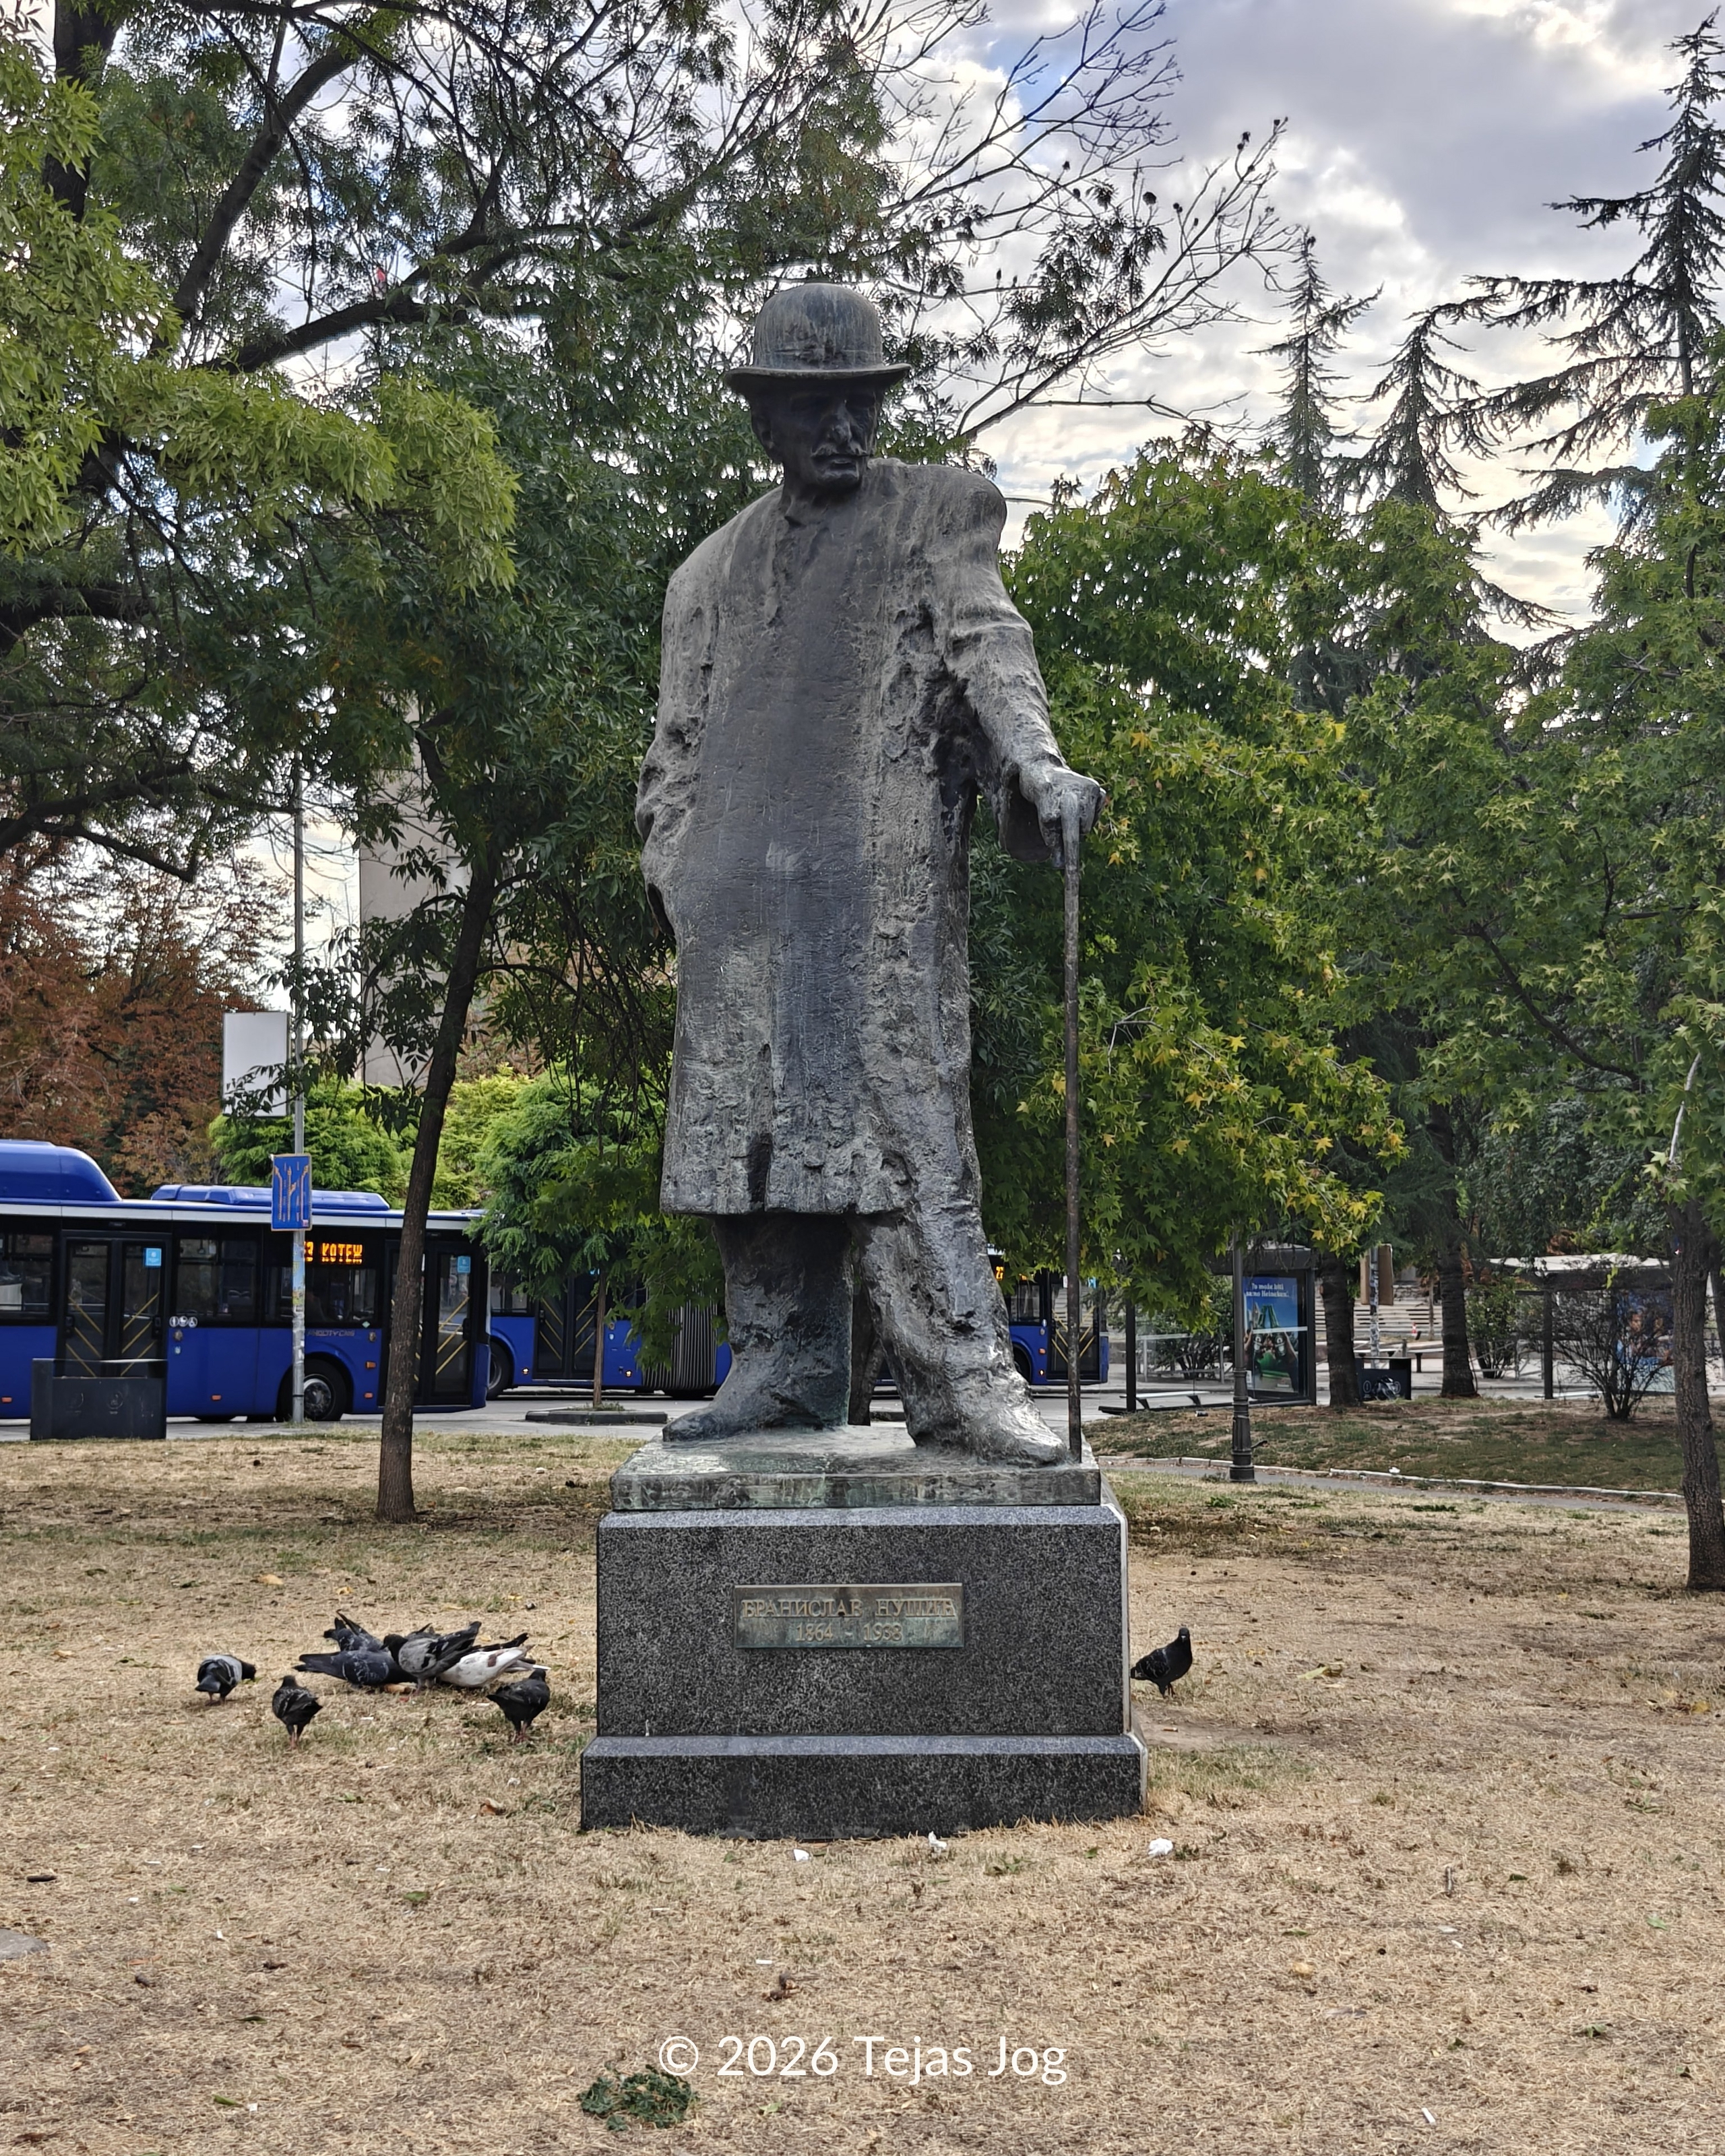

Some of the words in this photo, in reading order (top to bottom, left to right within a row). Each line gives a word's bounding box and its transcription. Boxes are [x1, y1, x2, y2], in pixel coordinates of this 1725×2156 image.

[742, 1598, 863, 1617] БРАНИСЛАВ
[875, 1598, 956, 1617] НУШИЋ
[796, 1622, 834, 1642] 1864
[862, 1622, 903, 1642] 1938
